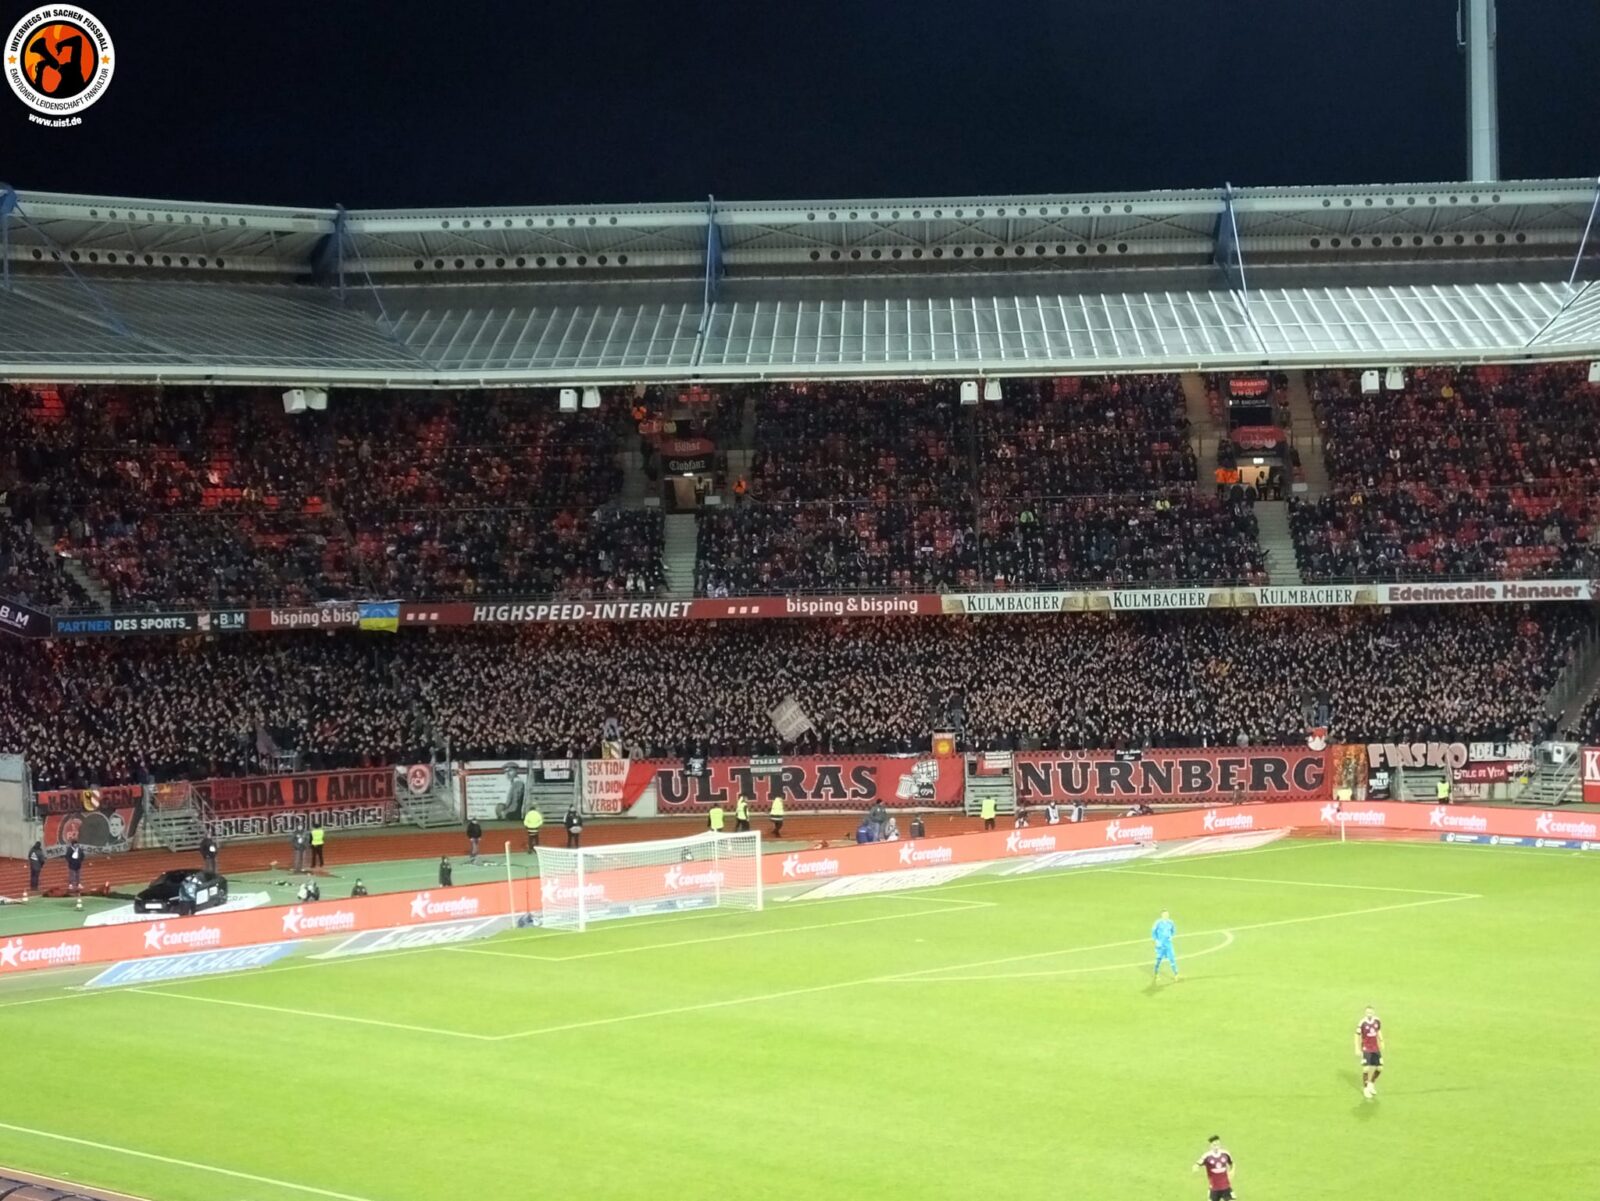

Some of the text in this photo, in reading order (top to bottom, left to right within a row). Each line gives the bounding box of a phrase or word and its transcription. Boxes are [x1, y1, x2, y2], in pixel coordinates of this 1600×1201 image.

[1113, 590, 1206, 608] KULMBACHER
[1259, 586, 1354, 605] KULMBACHER
[1389, 582, 1582, 603] Edelmetalle Hanauer
[786, 598, 843, 615] bisping
[860, 597, 918, 615] bisping
[967, 593, 1060, 612] KULMBACHER
[271, 610, 319, 627] bisping
[333, 606, 360, 626] bisp
[473, 602, 692, 621] HIGHSPEED-INTERNET
[57, 620, 112, 632] PARTNER
[114, 619, 138, 630] DES
[586, 761, 625, 776] SEKTION
[1018, 752, 1325, 798] NÜRNBERG
[293, 778, 318, 803] DI
[327, 773, 395, 801] AMICI
[587, 780, 623, 794] STADION
[657, 766, 878, 804] ULTRAS
[1214, 814, 1253, 828] corendon
[1336, 808, 1385, 822] corendon
[1444, 816, 1487, 829] corendon
[1118, 824, 1154, 839] corendon
[1551, 822, 1597, 835] corendon
[1018, 835, 1056, 849] corendon
[912, 847, 952, 861] corendon
[796, 859, 839, 873] corendon
[556, 882, 604, 897] coredon
[427, 898, 479, 915] corendon
[300, 911, 355, 928] corendon
[163, 927, 221, 945] corendon
[20, 942, 81, 962] corendon
